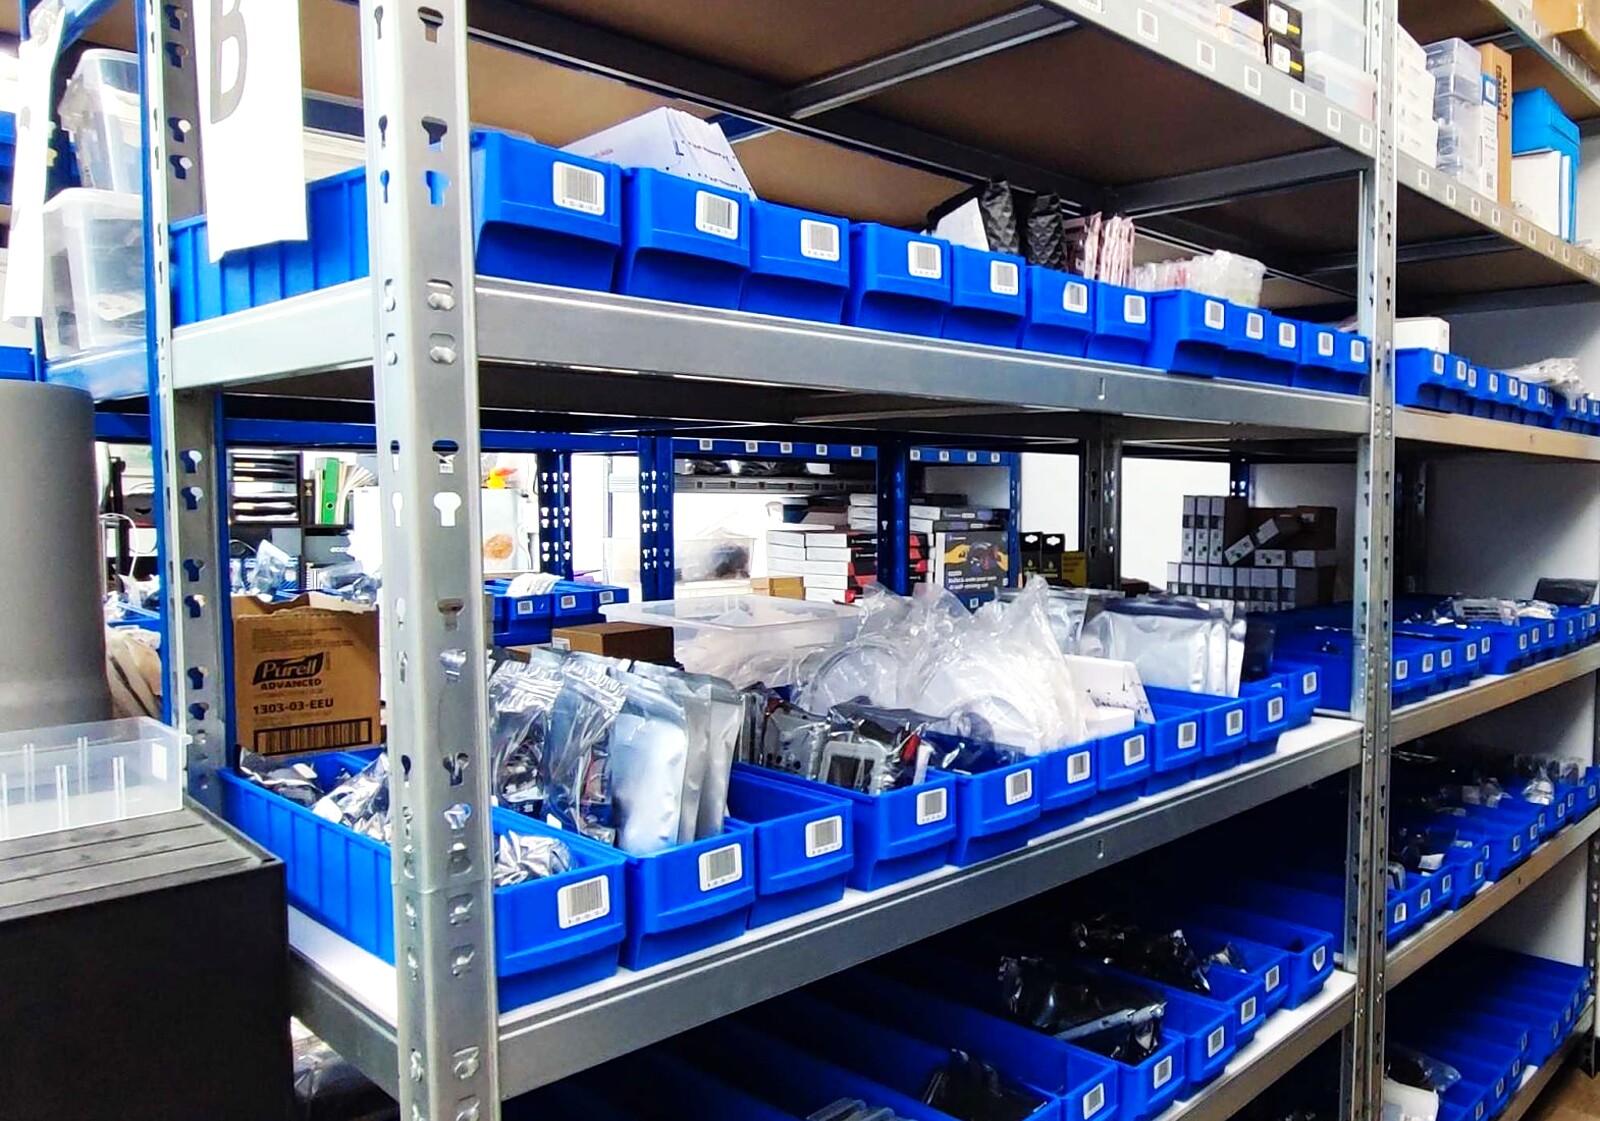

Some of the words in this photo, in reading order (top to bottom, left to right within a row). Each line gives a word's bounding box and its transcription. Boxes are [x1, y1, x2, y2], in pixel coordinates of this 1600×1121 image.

[210, 0, 247, 124] B
[262, 658, 317, 678] Purell
[261, 678, 322, 690] ADVANCED
[253, 697, 334, 714] 1303-03-EEU
